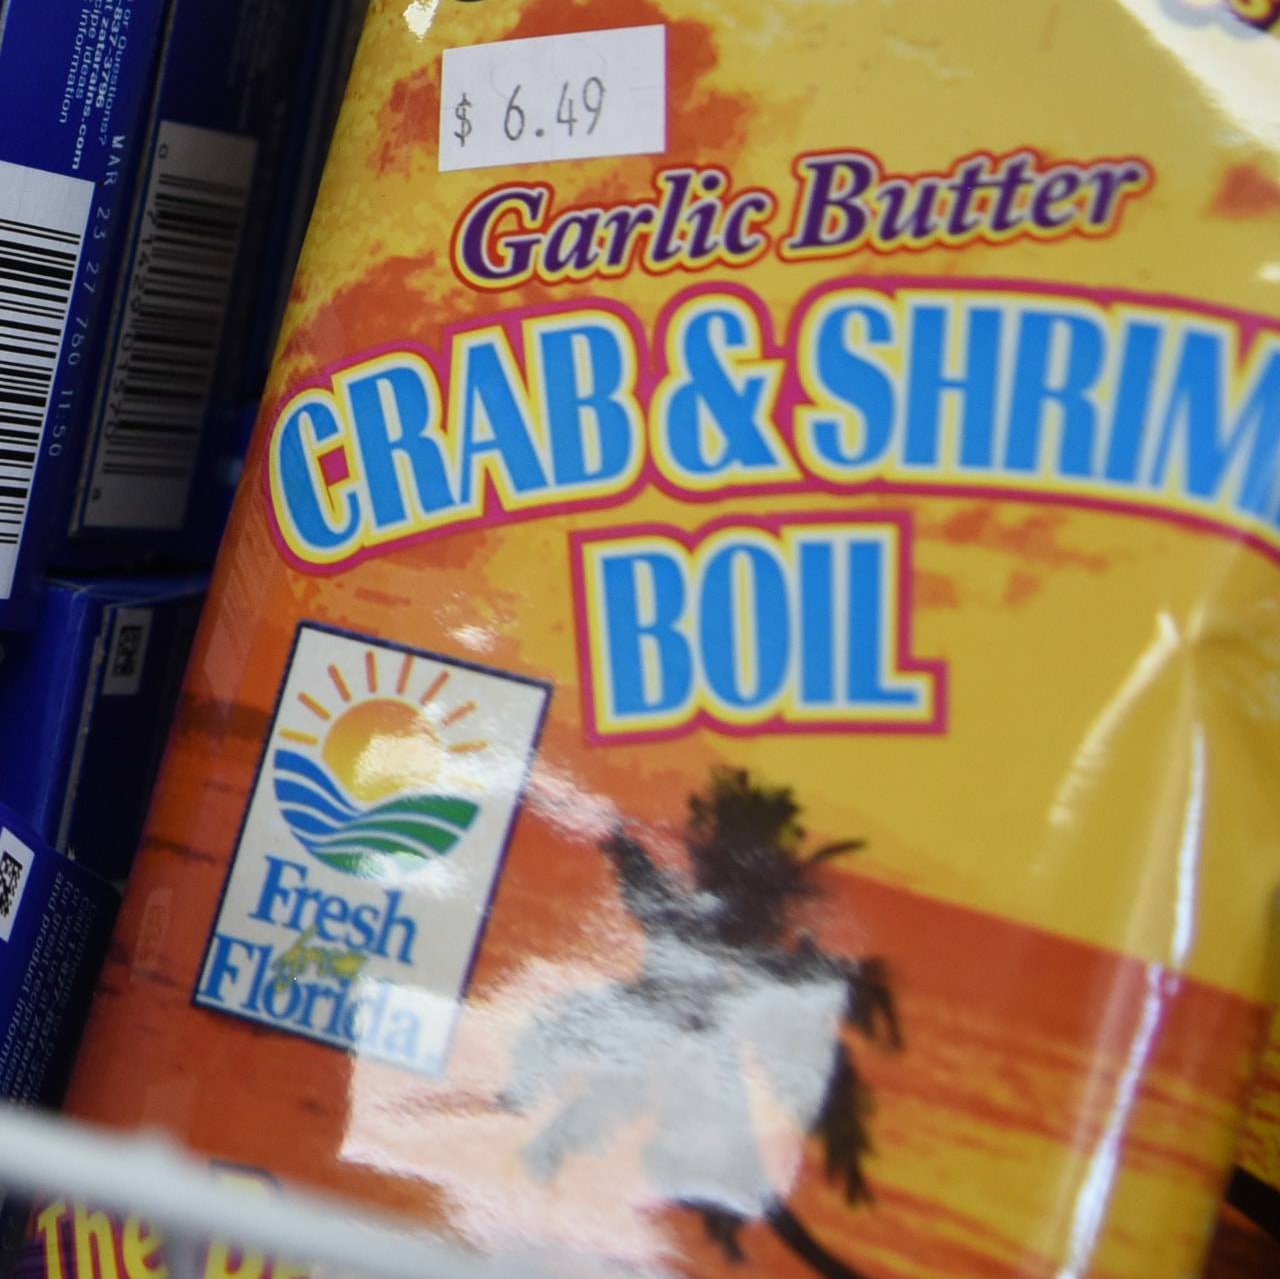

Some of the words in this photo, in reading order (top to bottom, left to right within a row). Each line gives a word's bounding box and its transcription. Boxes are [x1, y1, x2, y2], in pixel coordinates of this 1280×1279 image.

[58, 7, 90, 124] information
[75, 45, 93, 100] ideas
[120, 7, 130, 30] or
[71, 16, 110, 170] zatarains.com
[96, 34, 126, 143] Questions?
[452, 91, 473, 146] $
[502, 75, 607, 143] 6.49
[104, 134, 126, 187] MAR
[93, 206, 111, 239] 23
[458, 166, 768, 283] Garlic
[787, 153, 1143, 257] Butter
[274, 311, 642, 557] CRAB
[655, 301, 792, 481] &
[590, 533, 928, 721] BOIL
[248, 853, 418, 967] Fresh
